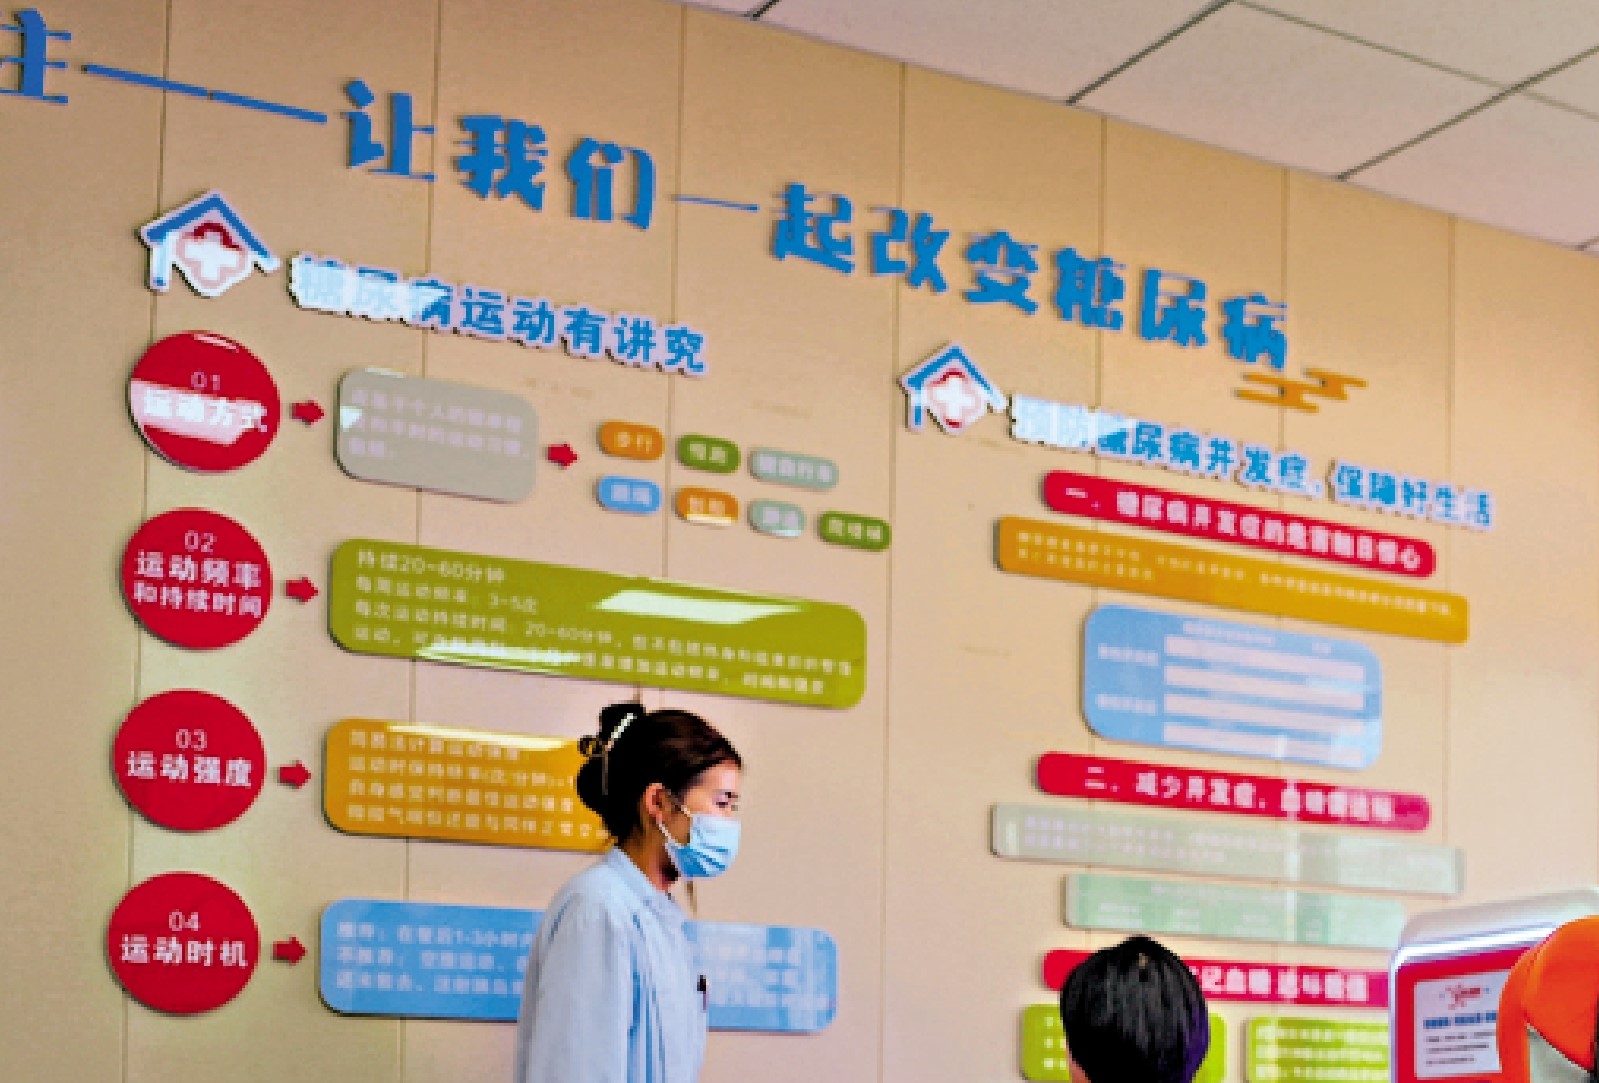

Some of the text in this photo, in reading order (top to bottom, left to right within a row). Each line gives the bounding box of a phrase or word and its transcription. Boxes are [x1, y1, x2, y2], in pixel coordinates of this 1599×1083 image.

[190, 371, 222, 392] 01
[183, 531, 219, 552] 02
[134, 550, 263, 590] 运动频率
[132, 585, 264, 618] 和持续时间
[175, 728, 209, 750] 03
[126, 751, 255, 788] 运动强度
[168, 910, 202, 932] 04
[119, 932, 250, 969] 运动时机
